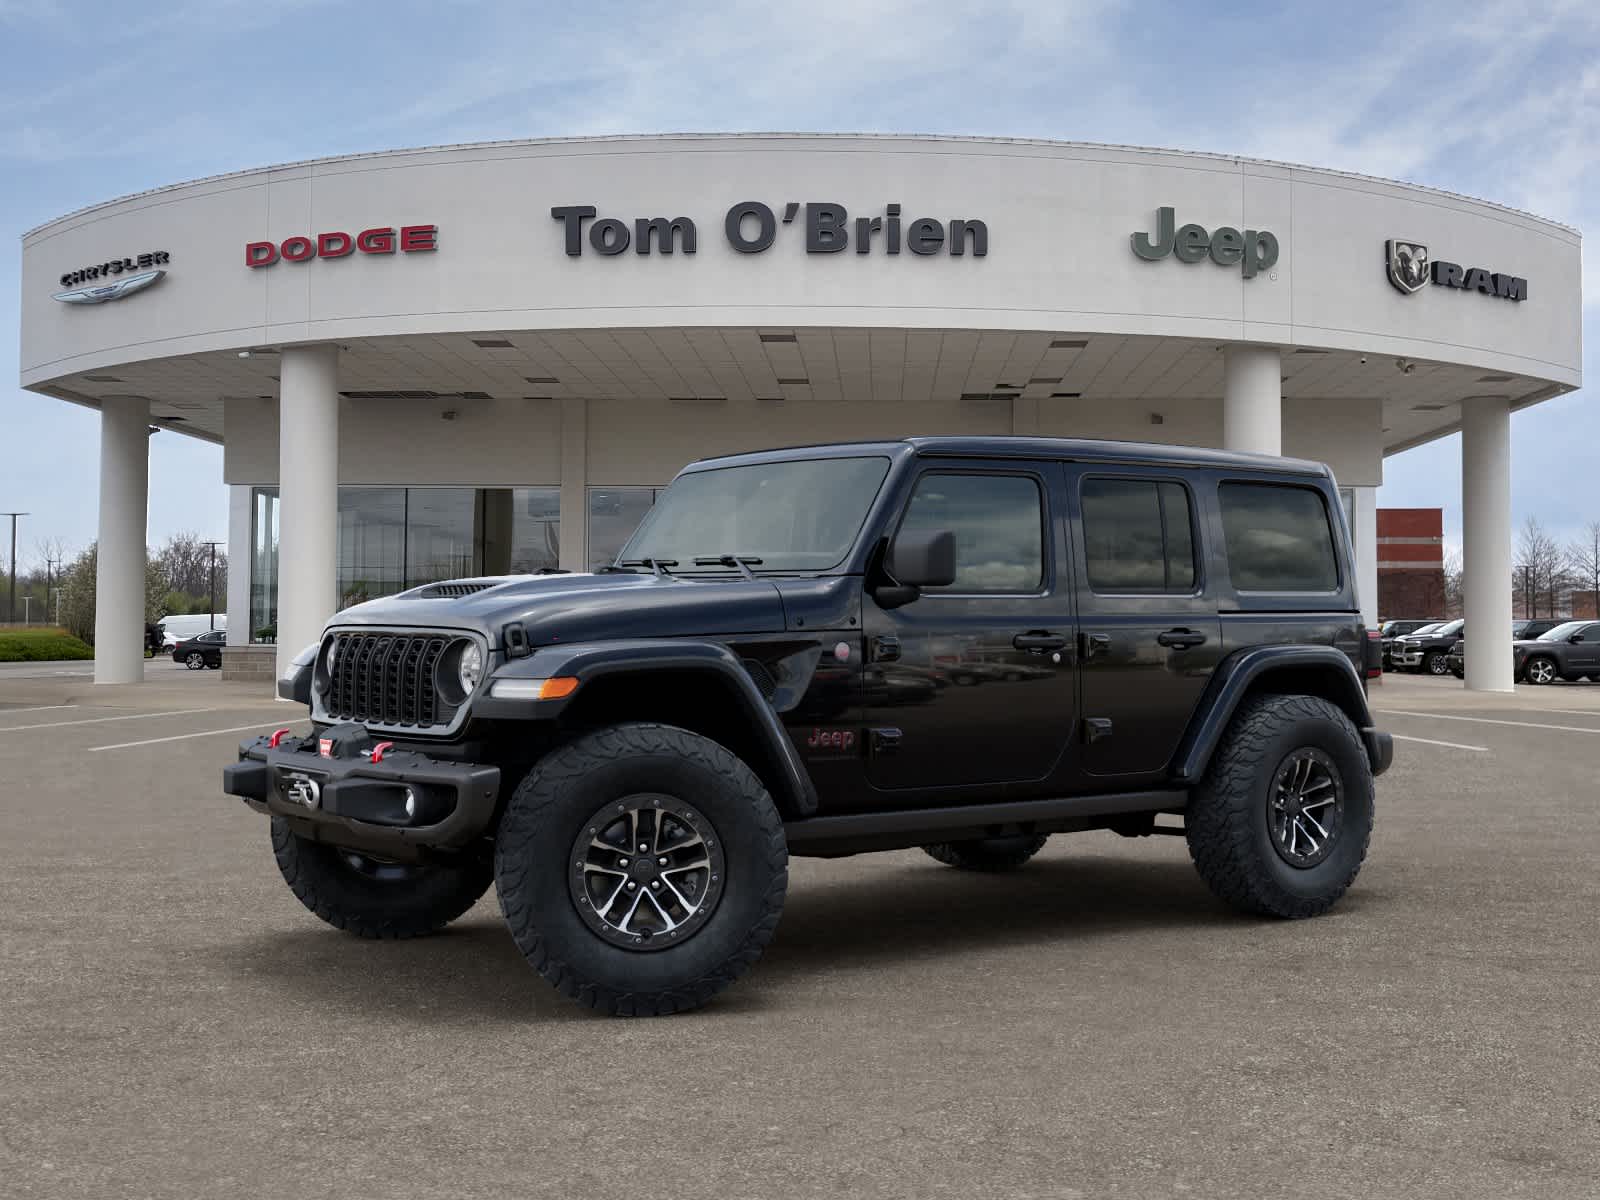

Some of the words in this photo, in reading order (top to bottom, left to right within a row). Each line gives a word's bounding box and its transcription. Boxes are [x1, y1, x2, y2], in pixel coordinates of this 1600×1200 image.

[245, 224, 438, 269] DODGE
[550, 205, 697, 257] Tom
[725, 201, 989, 257] O'Brien
[1130, 206, 1279, 279] Jeep
[60, 250, 170, 287] CHRYSLER
[1430, 260, 1528, 302] RAM
[808, 727, 856, 752] Jeep
